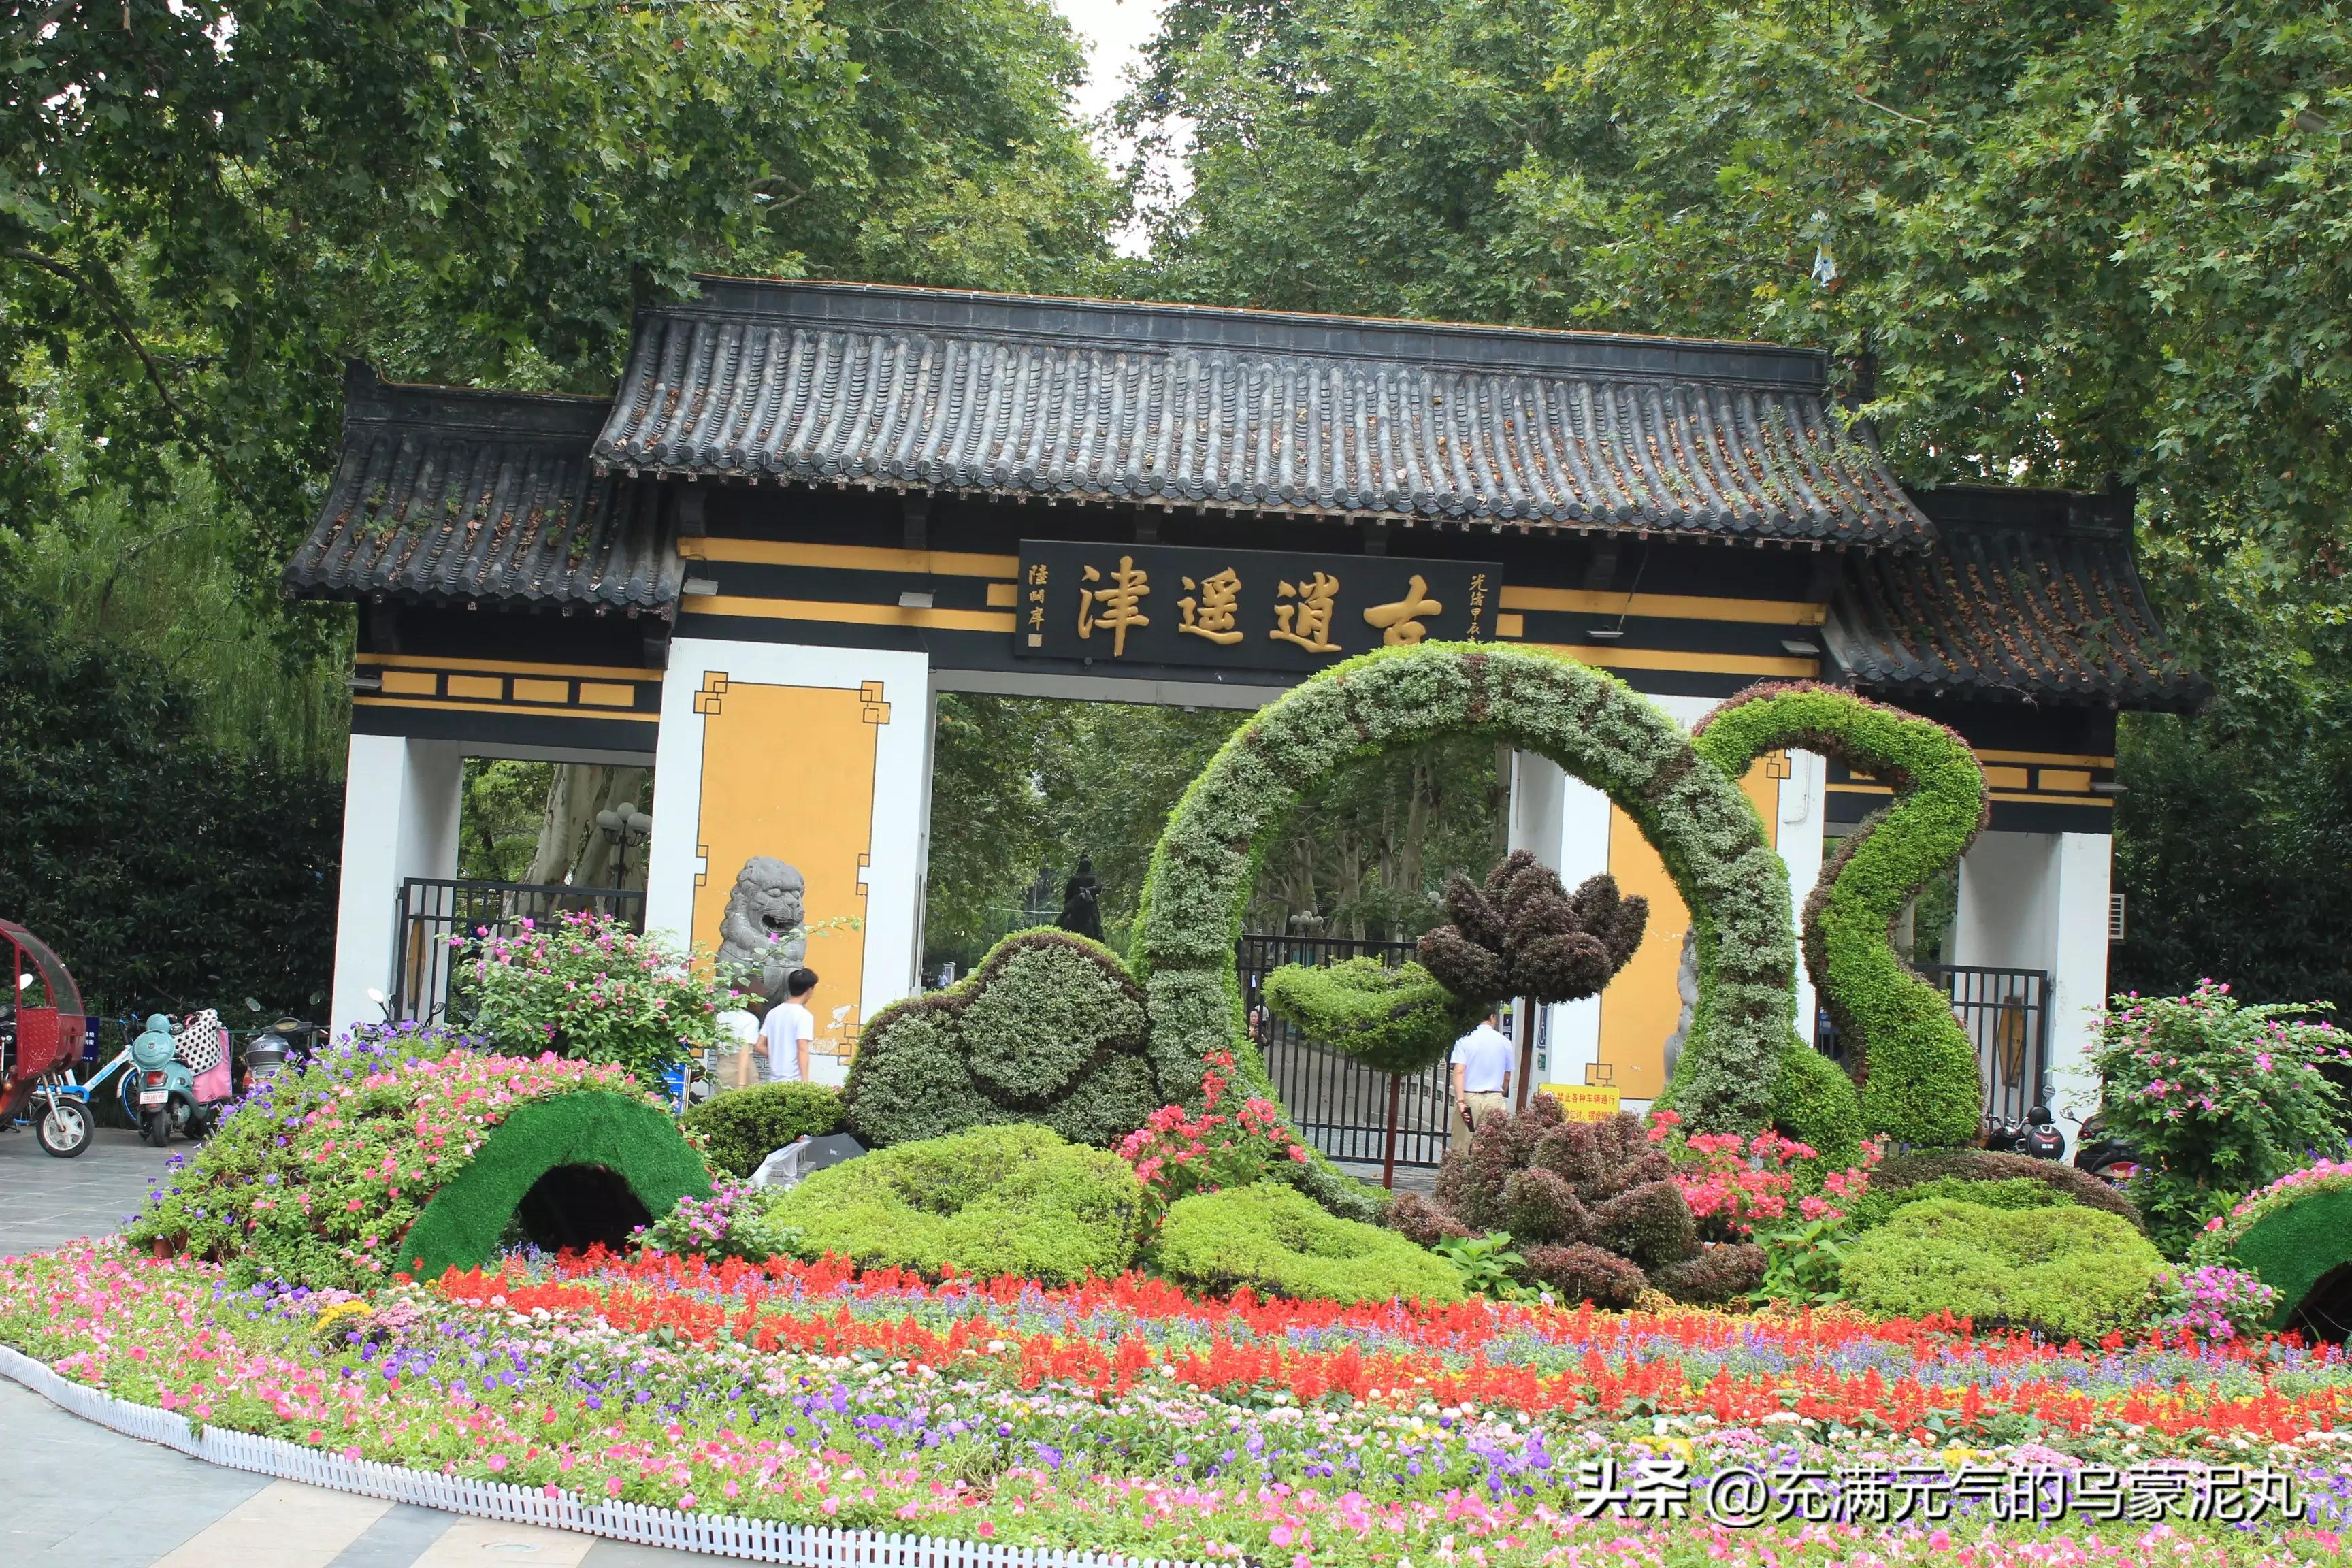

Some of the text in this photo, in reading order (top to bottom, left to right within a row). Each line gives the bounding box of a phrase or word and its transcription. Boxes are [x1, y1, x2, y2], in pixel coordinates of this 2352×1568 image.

[1556, 1092, 1616, 1105] 禁止各种车辆通行
